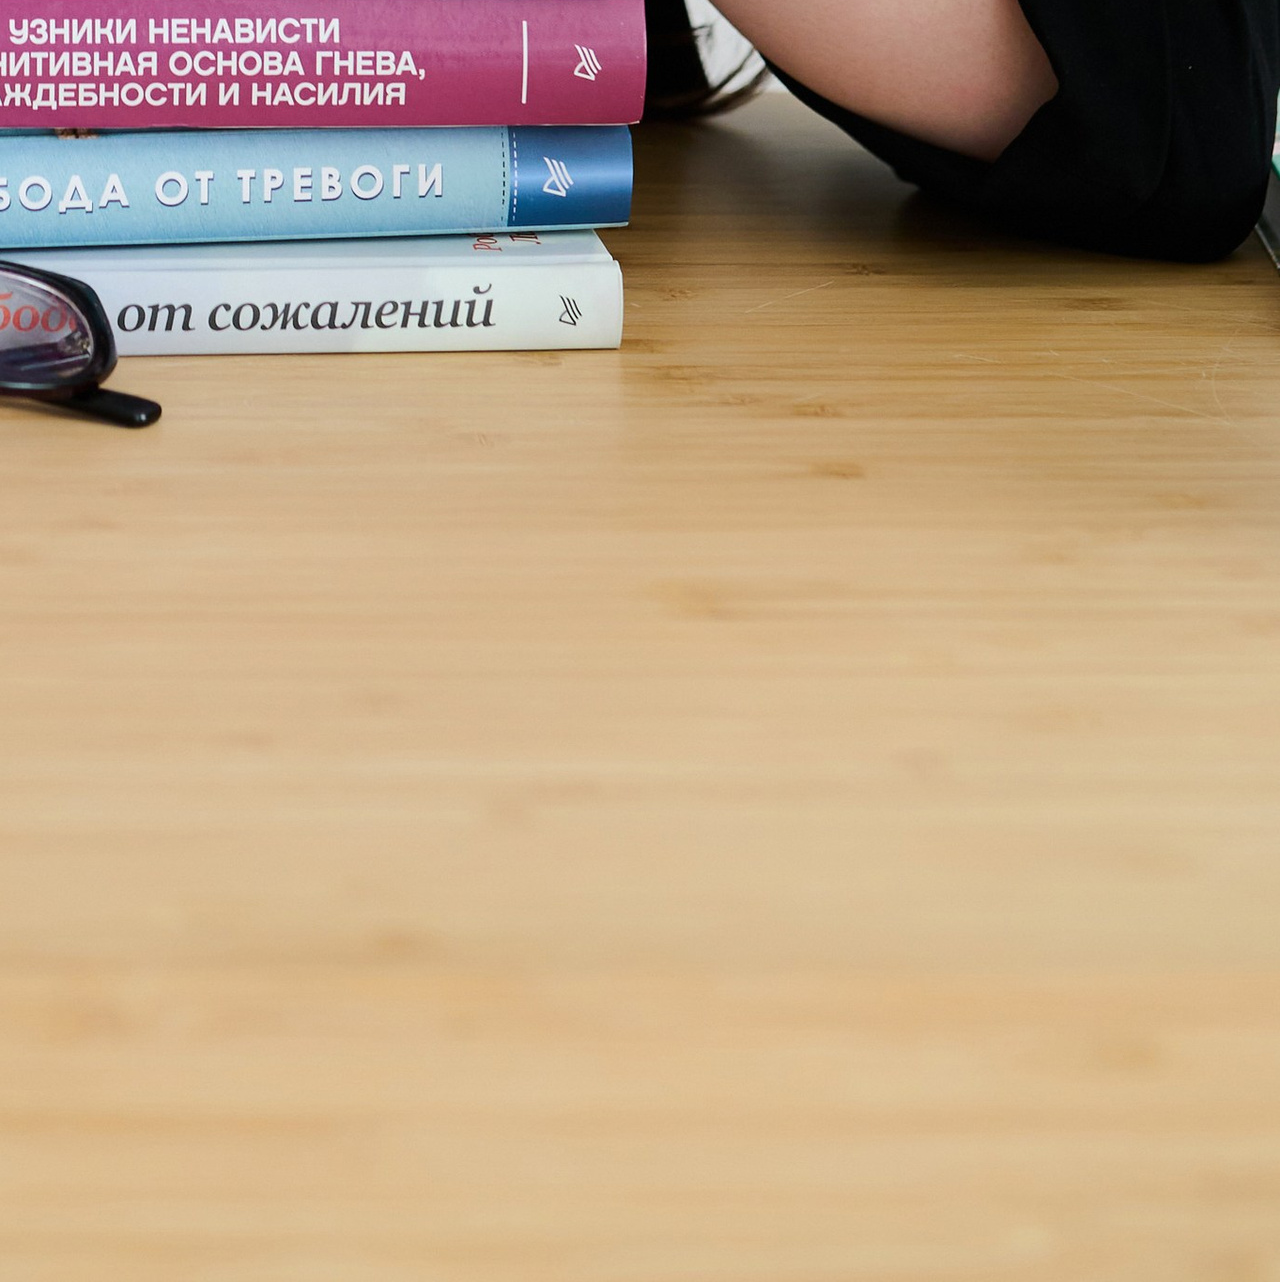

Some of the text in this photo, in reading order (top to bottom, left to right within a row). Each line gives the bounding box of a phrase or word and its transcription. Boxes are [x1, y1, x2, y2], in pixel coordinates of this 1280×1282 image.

[9, 17, 340, 45] УЗНИКИ НЕНАВИСТИ
[168, 50, 305, 77] ОСНОВА
[315, 50, 426, 80] ГНЕВА,
[218, 82, 240, 106] И
[251, 81, 406, 106] НАСИЛИЯ
[154, 170, 214, 205] ОТ
[236, 163, 442, 202] ТРЕВОГИ
[116, 303, 195, 333] от
[207, 283, 496, 332] сожалений
